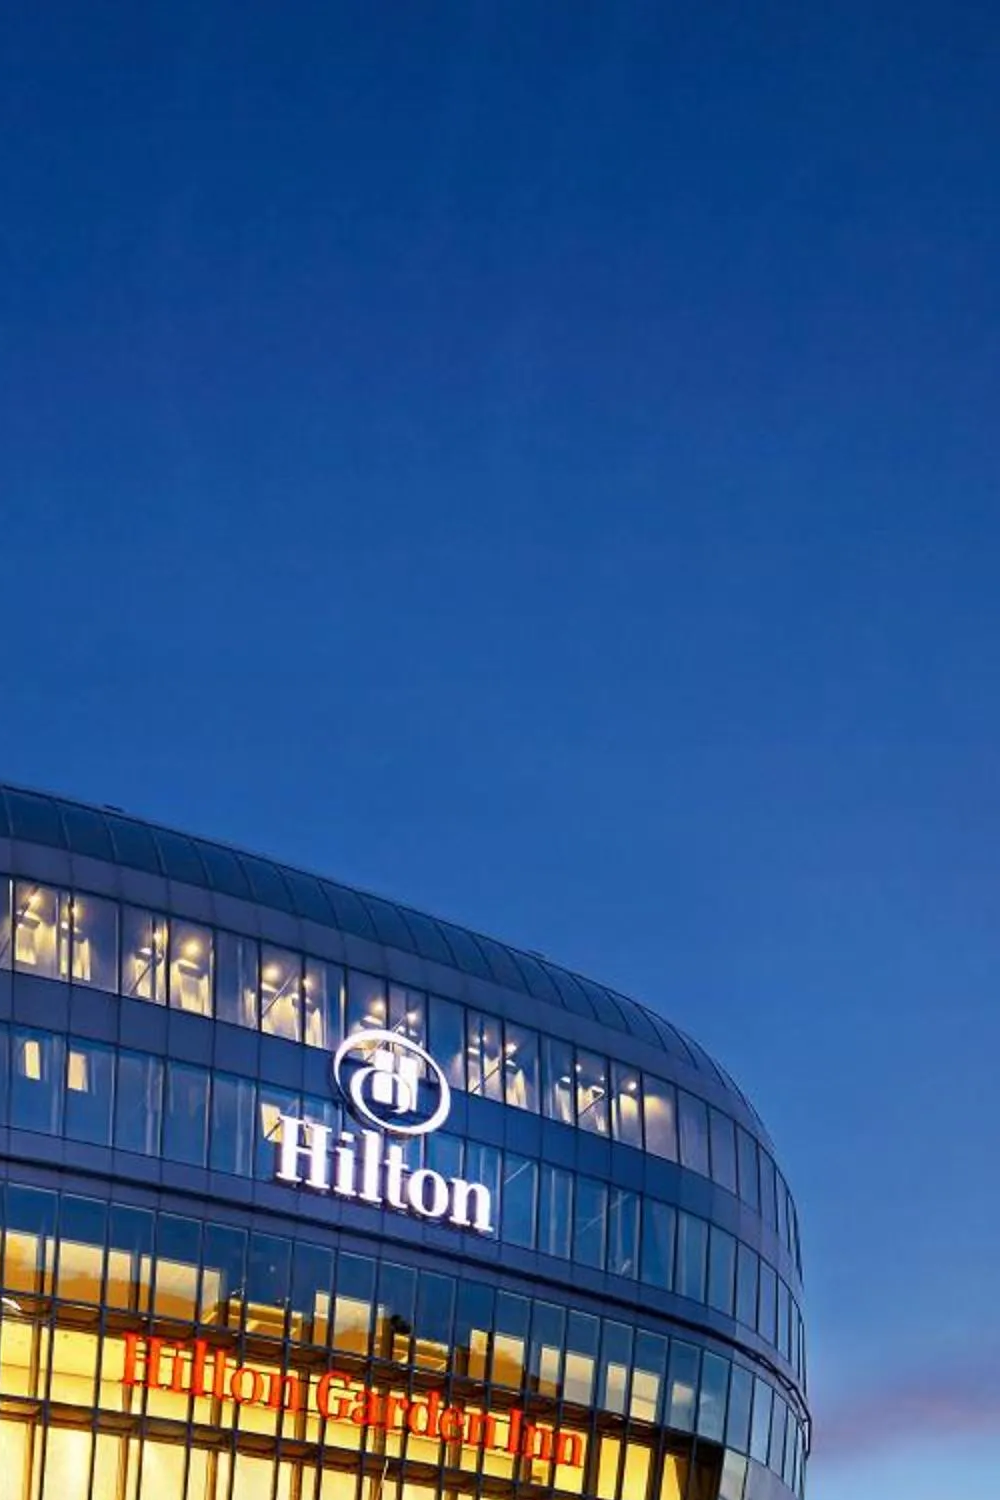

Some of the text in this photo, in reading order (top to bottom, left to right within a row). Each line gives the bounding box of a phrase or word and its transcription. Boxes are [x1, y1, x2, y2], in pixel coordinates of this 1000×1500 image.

[276, 1114, 493, 1231] Hilton
[122, 1331, 583, 1467] Hilton Garden Inn
